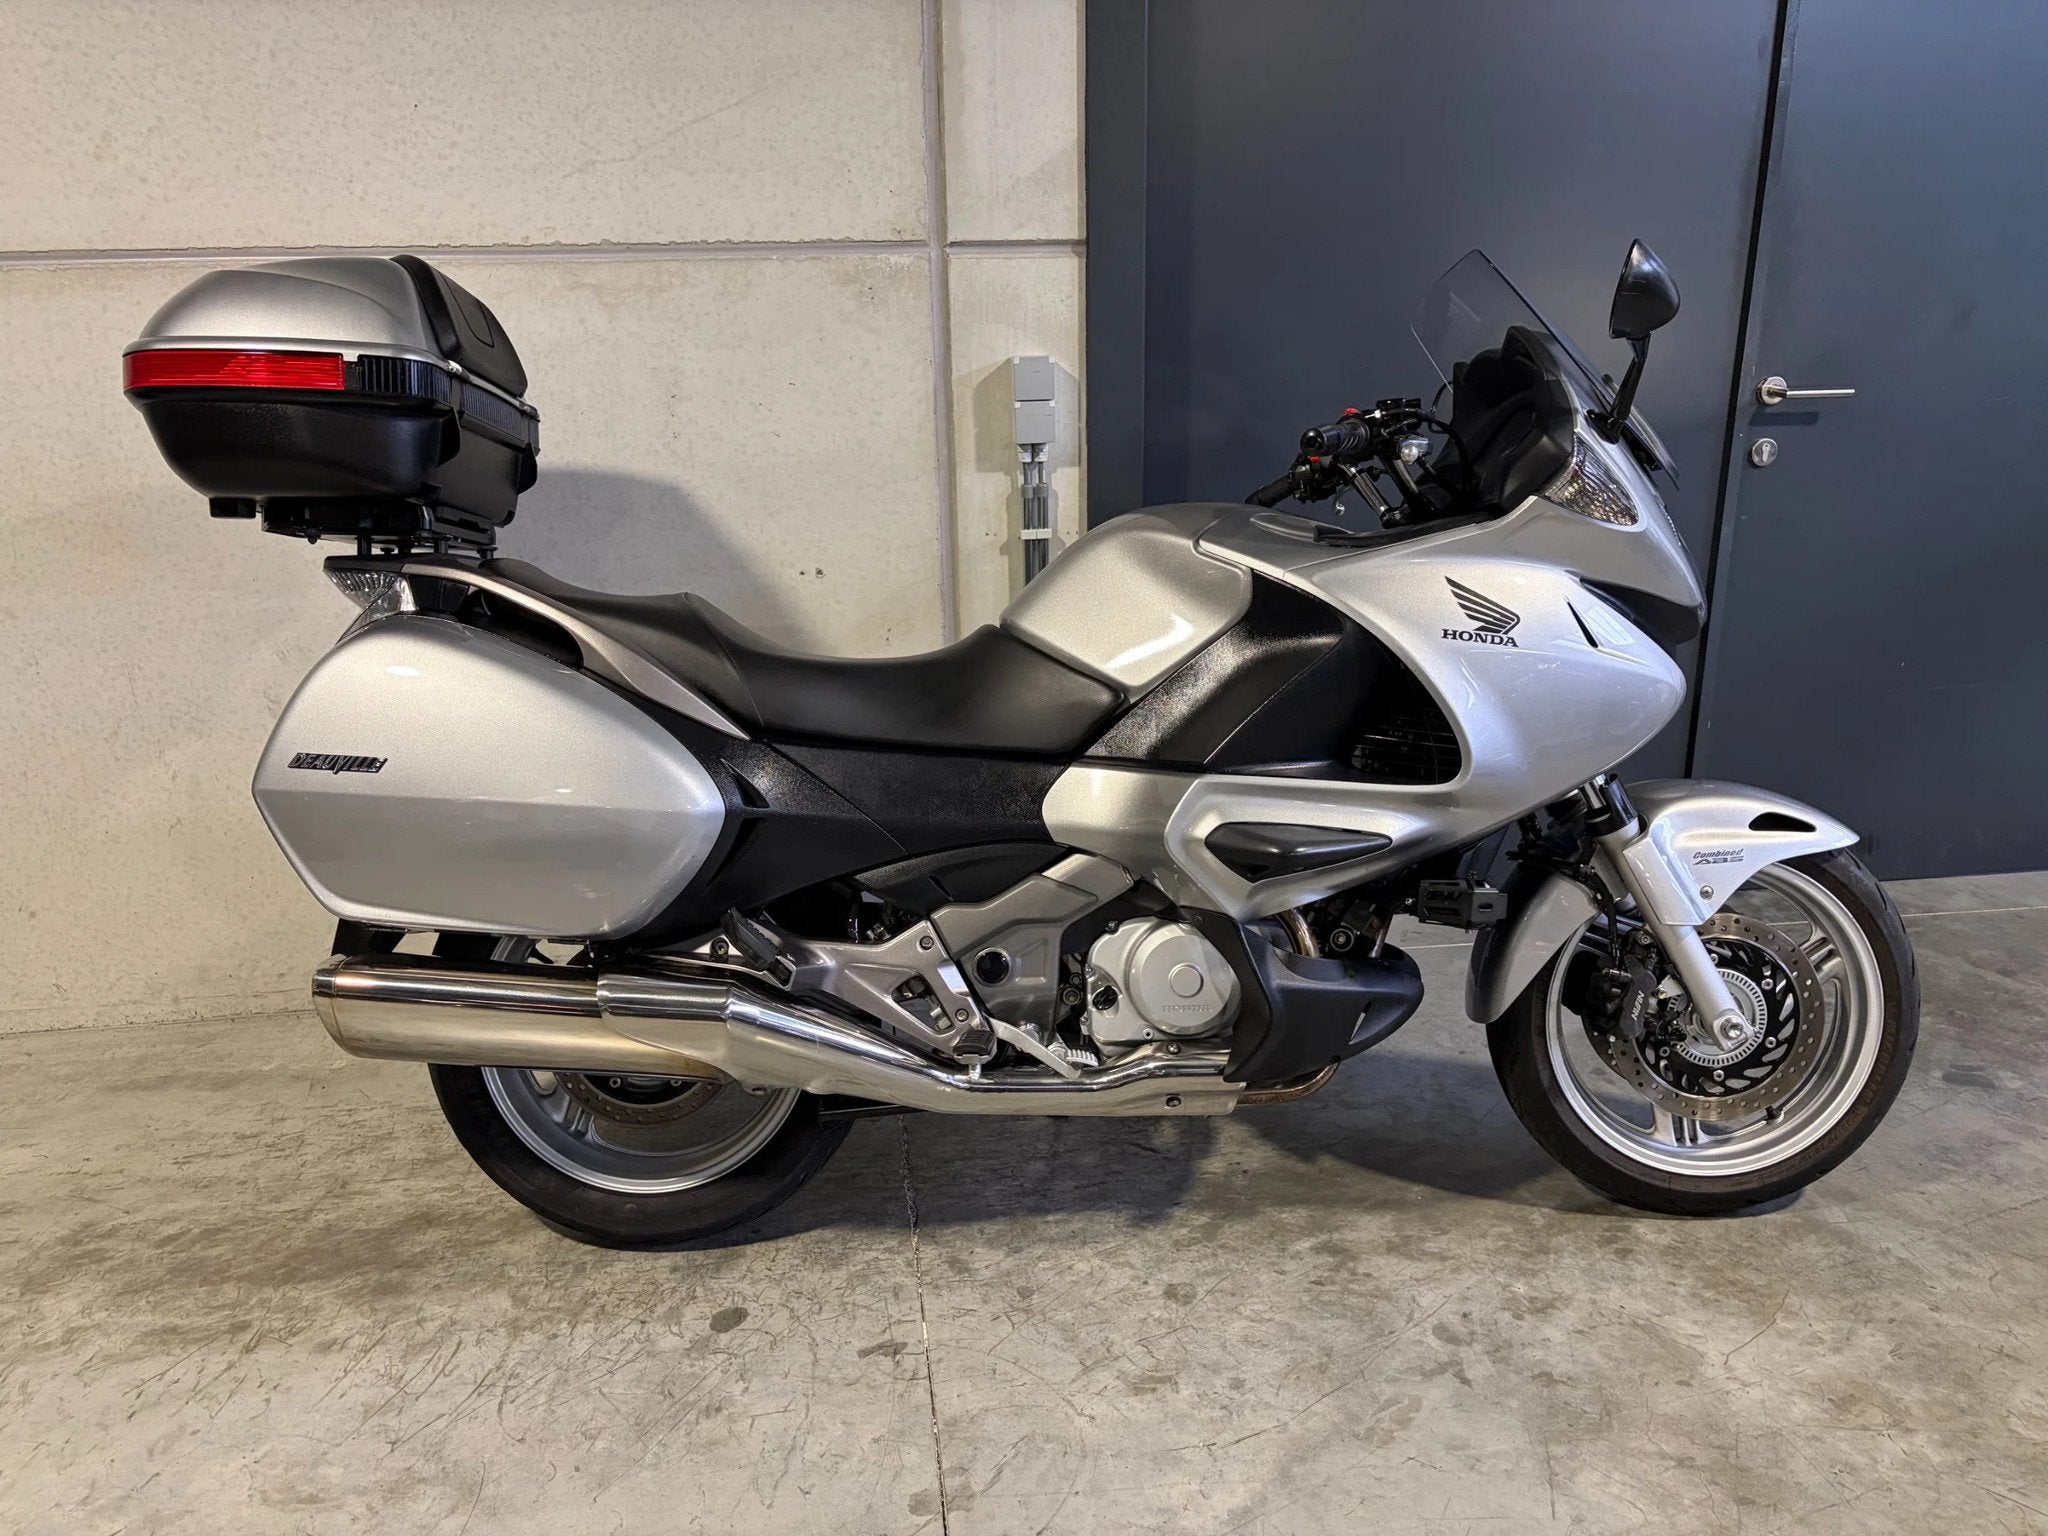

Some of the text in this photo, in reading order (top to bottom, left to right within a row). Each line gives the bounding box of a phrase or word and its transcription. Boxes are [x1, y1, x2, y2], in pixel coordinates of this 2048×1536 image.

[1441, 628, 1519, 648] HONDA
[287, 752, 388, 775] DEAUVILLE
[1692, 848, 1744, 859] Combined
[1693, 855, 1744, 866] ABS
